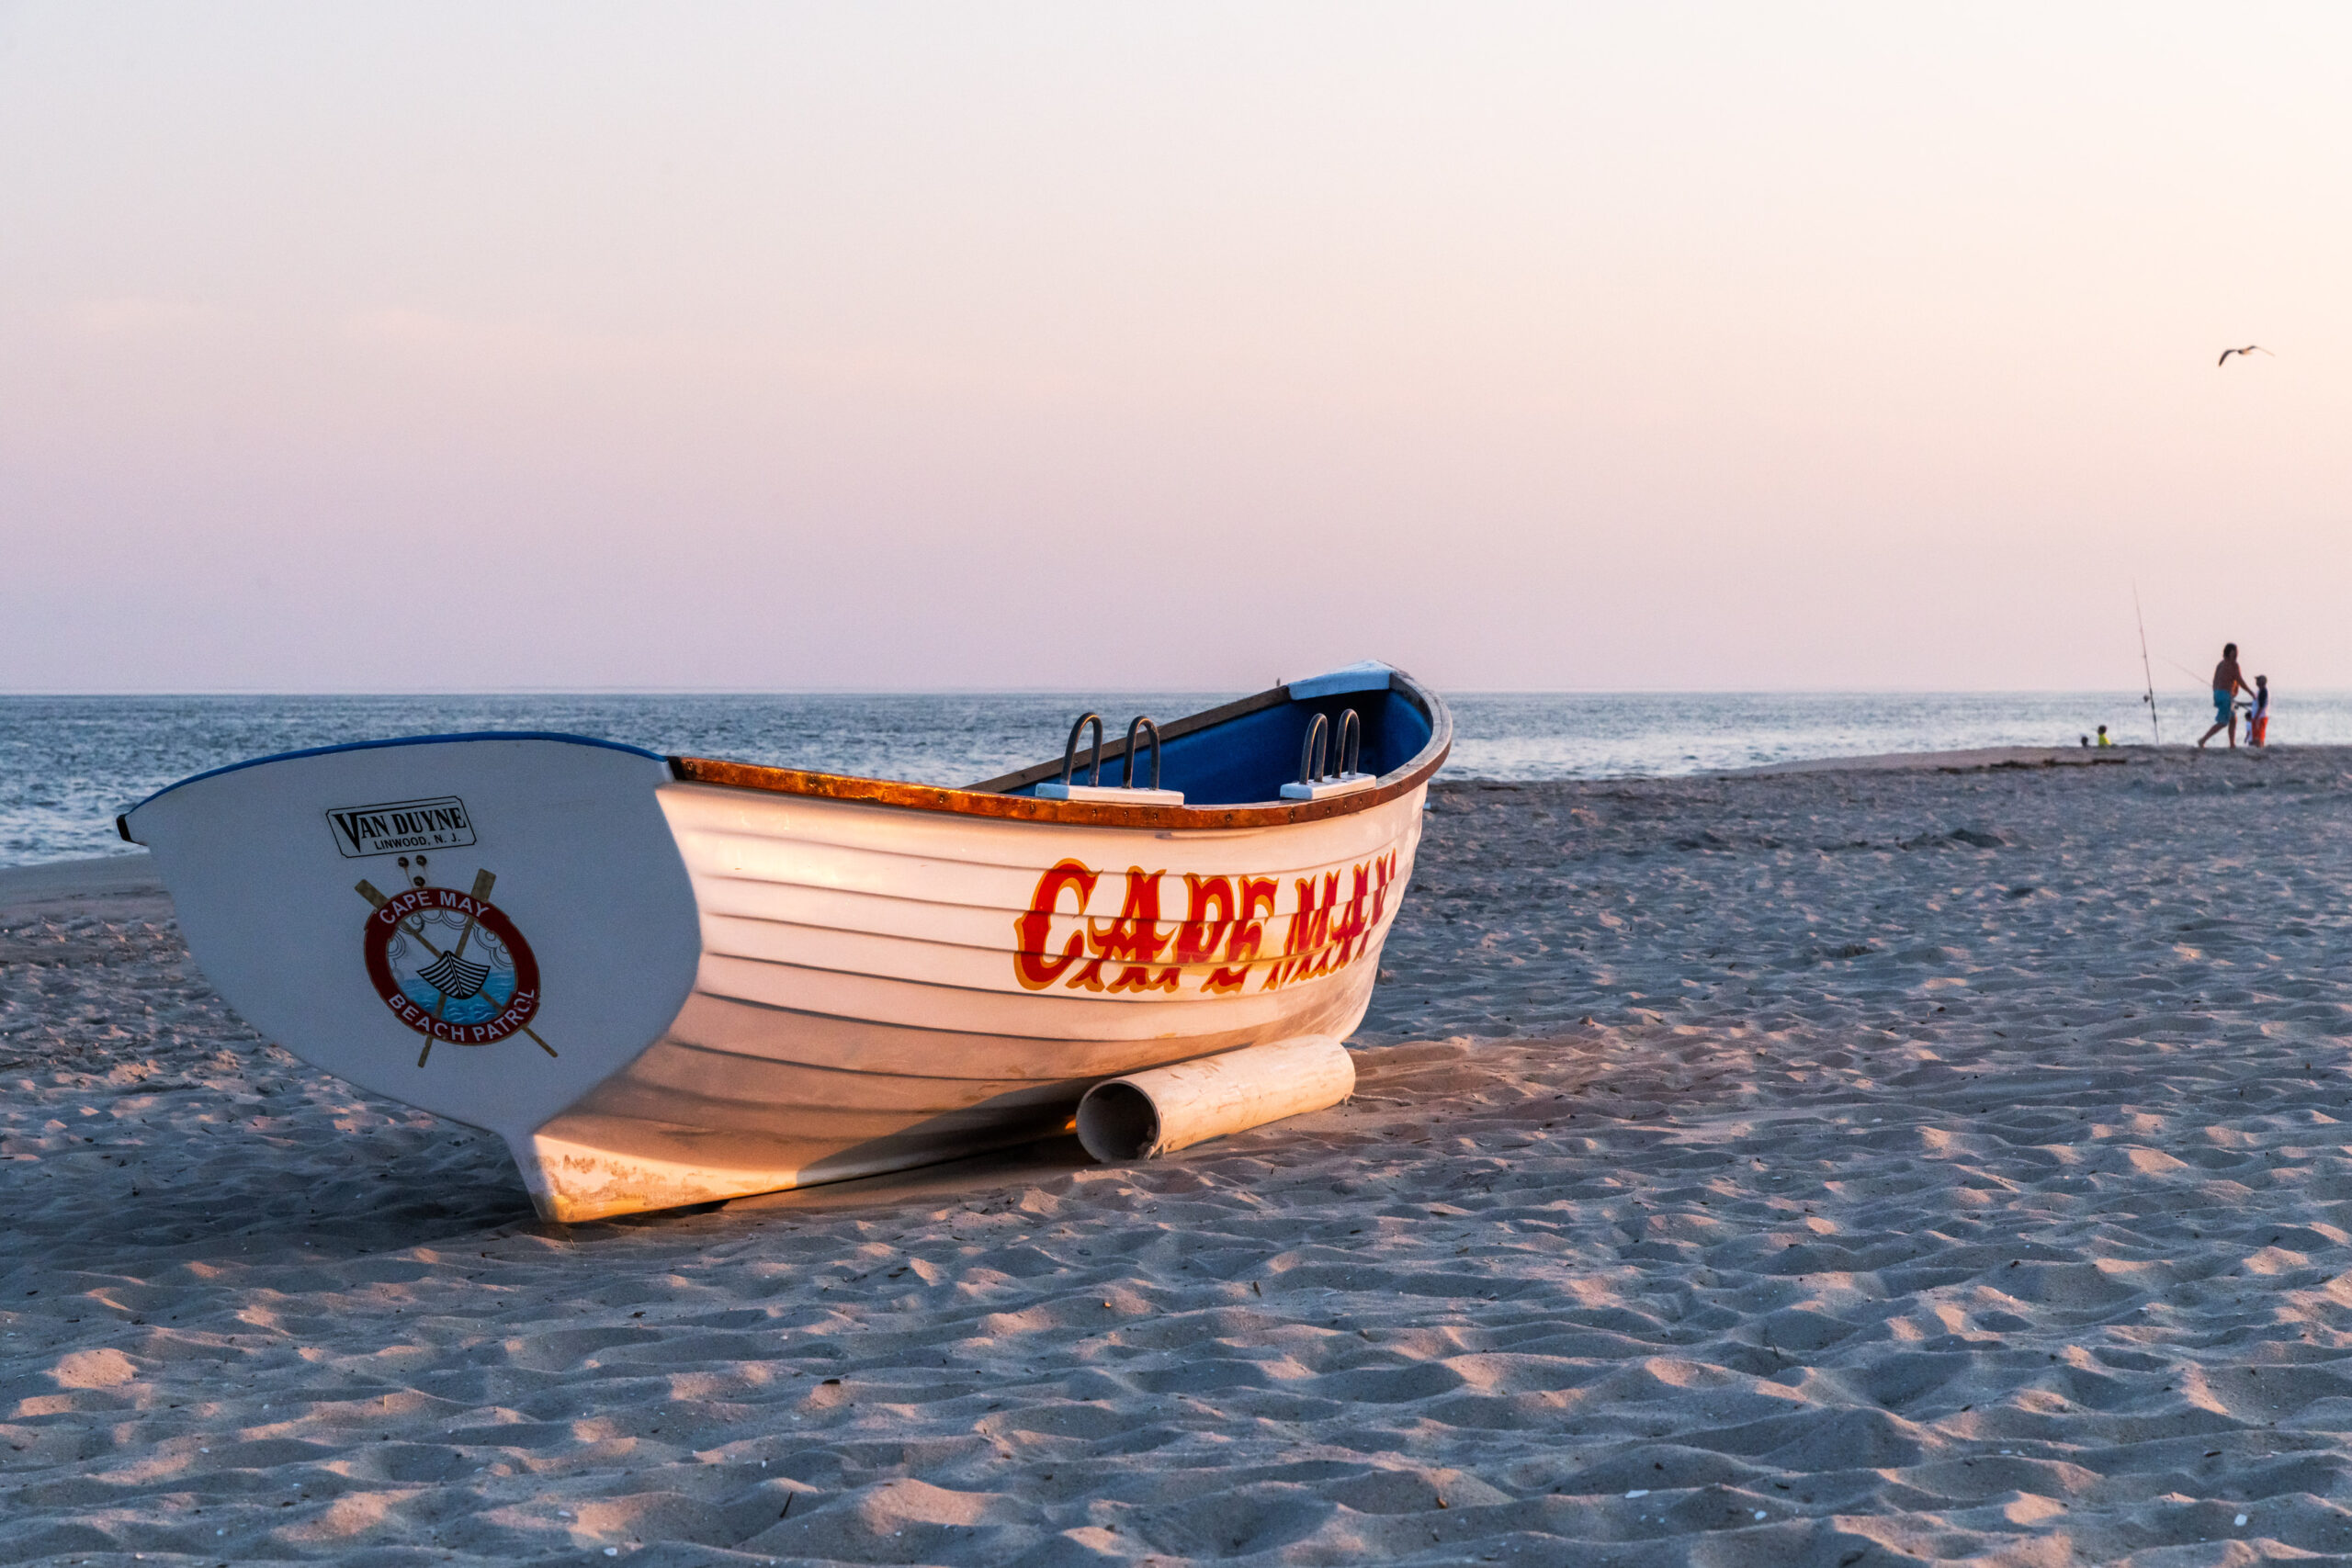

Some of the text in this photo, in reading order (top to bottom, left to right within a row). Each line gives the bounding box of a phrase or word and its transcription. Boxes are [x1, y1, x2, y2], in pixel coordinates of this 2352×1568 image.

[333, 808, 466, 852] VAN DUYNE
[374, 833, 461, 851] LINWOOD, N. J.
[379, 891, 489, 924] CAPE MAY
[1013, 848, 1396, 995] CAPE MAY
[389, 988, 535, 1042] BEACH PATROL
